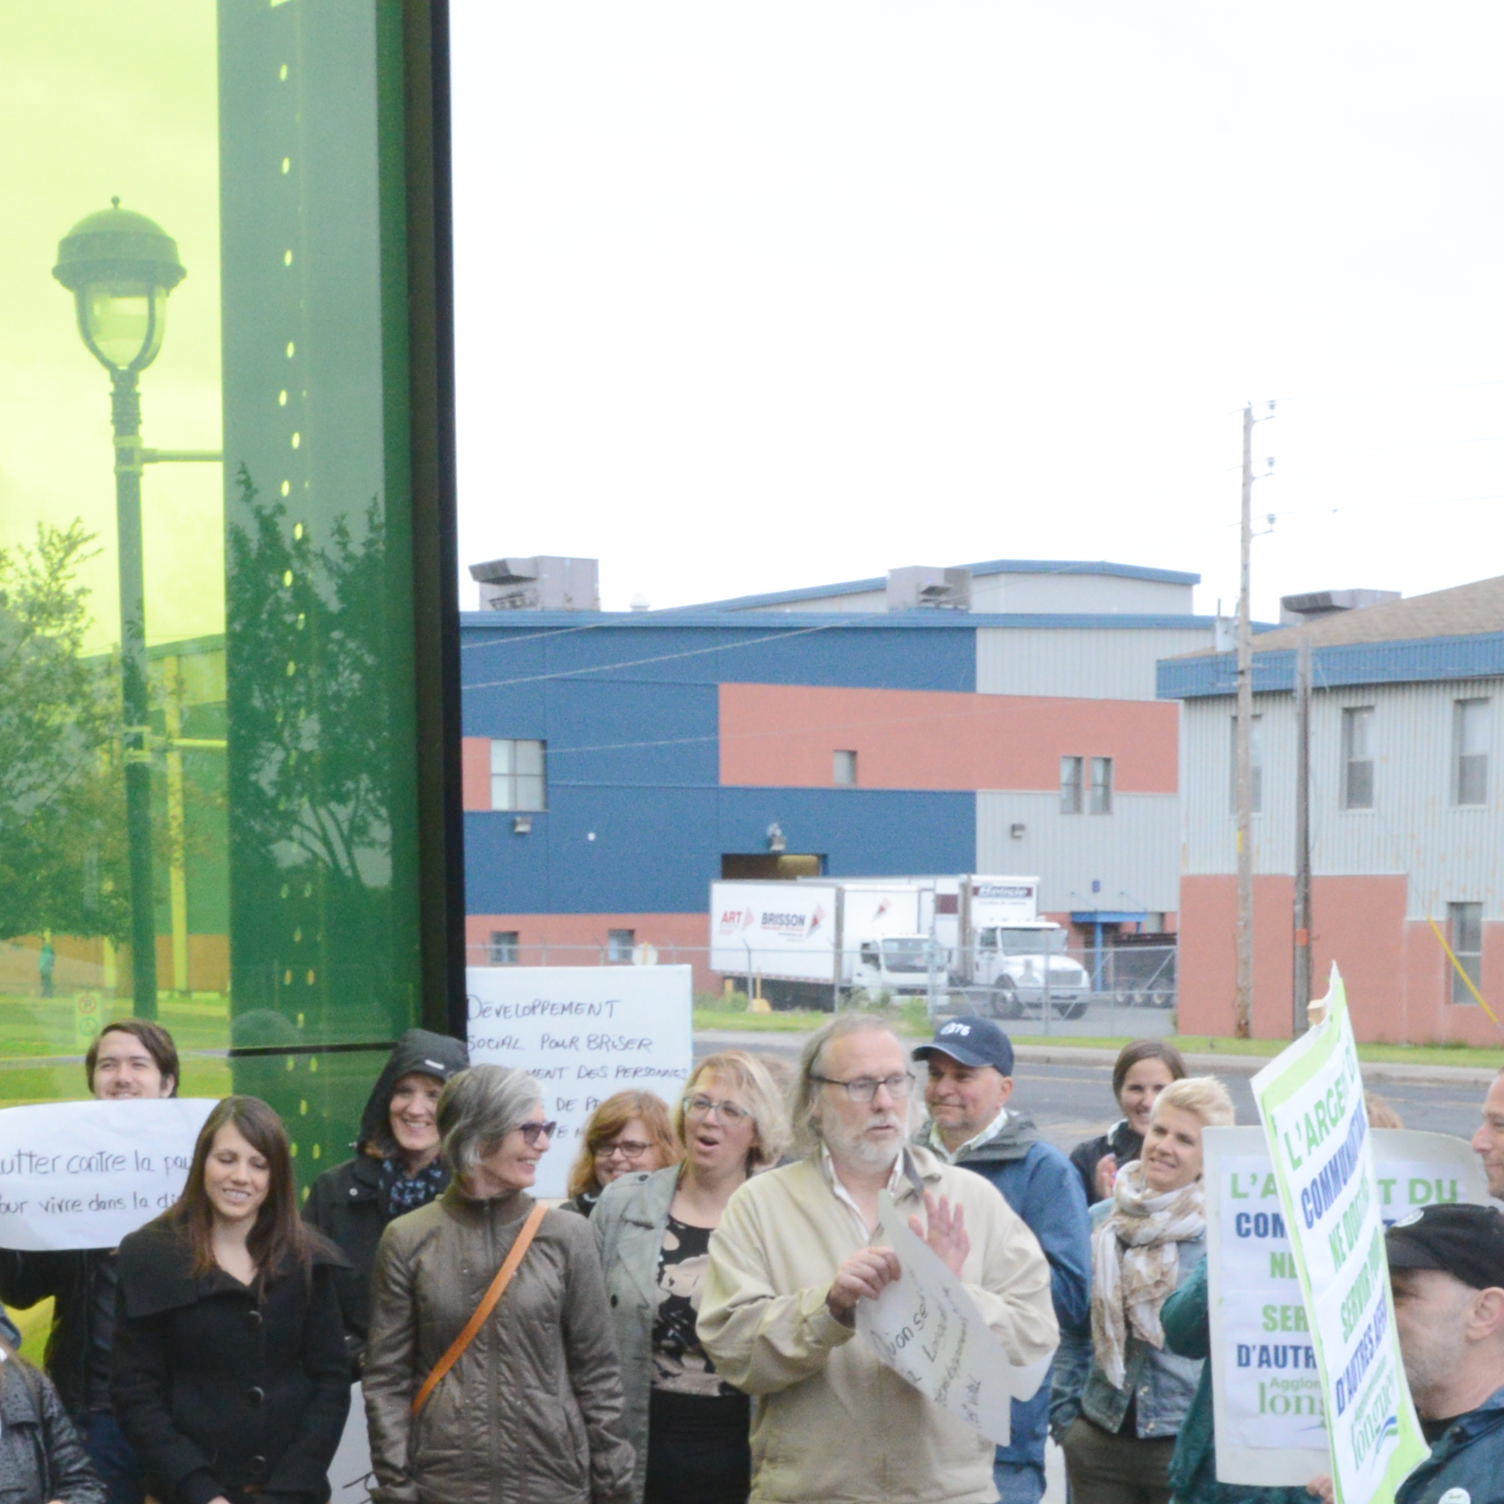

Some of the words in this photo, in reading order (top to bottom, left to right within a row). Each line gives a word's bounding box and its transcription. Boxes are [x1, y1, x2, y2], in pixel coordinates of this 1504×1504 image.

[721, 911, 743, 924] ART
[761, 911, 806, 926] BRISSON
[134, 1149, 156, 1173] la
[88, 1192, 127, 1209] dans
[133, 1191, 150, 1208] la
[1408, 1177, 1458, 1204] DU
